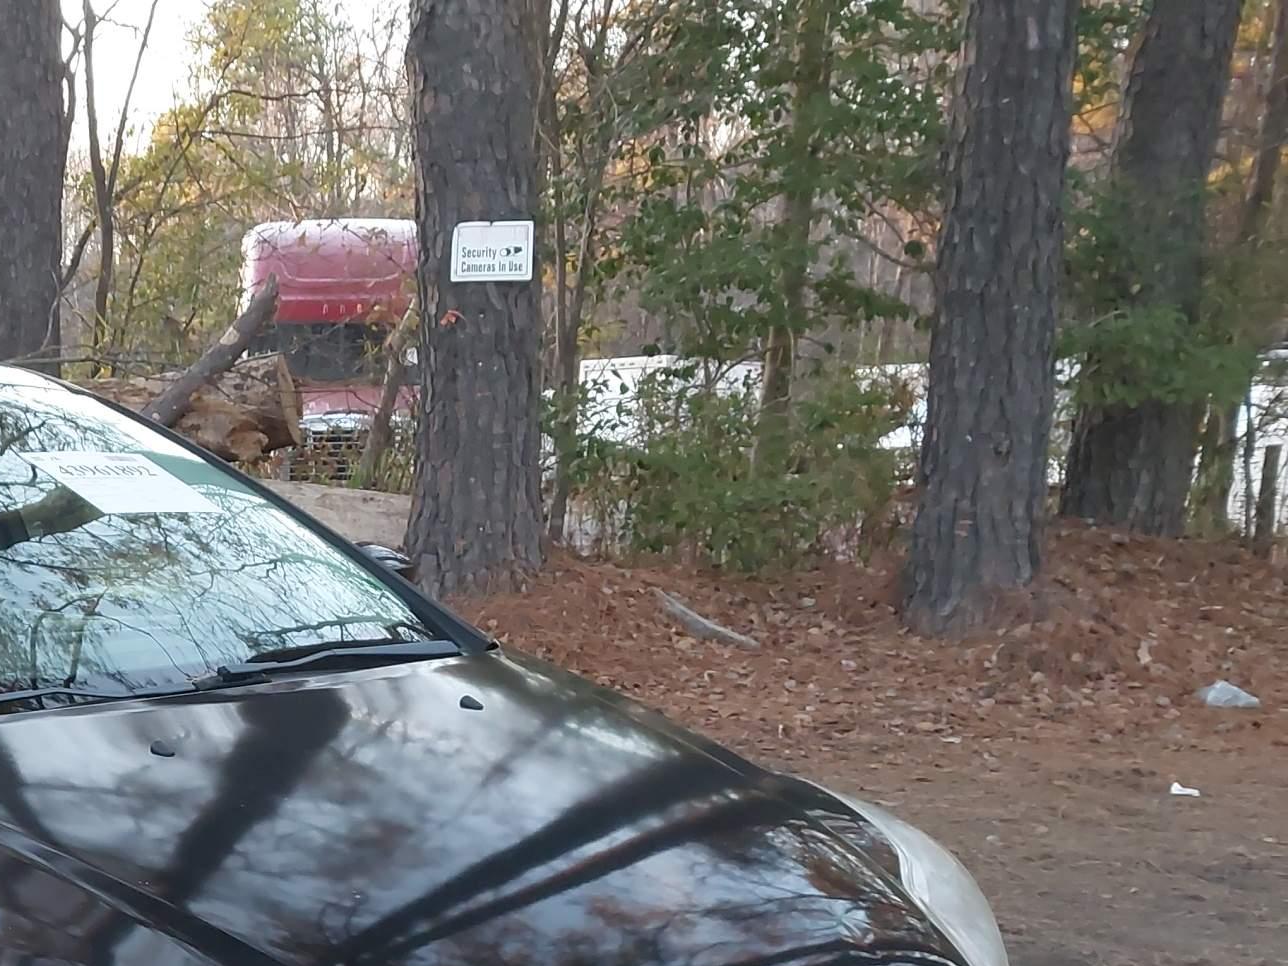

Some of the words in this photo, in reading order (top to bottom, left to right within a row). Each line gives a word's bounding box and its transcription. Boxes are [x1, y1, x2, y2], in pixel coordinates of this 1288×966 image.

[461, 246, 497, 262] Security
[461, 261, 496, 273] Cameras
[498, 261, 506, 272] In
[508, 261, 523, 272] Use
